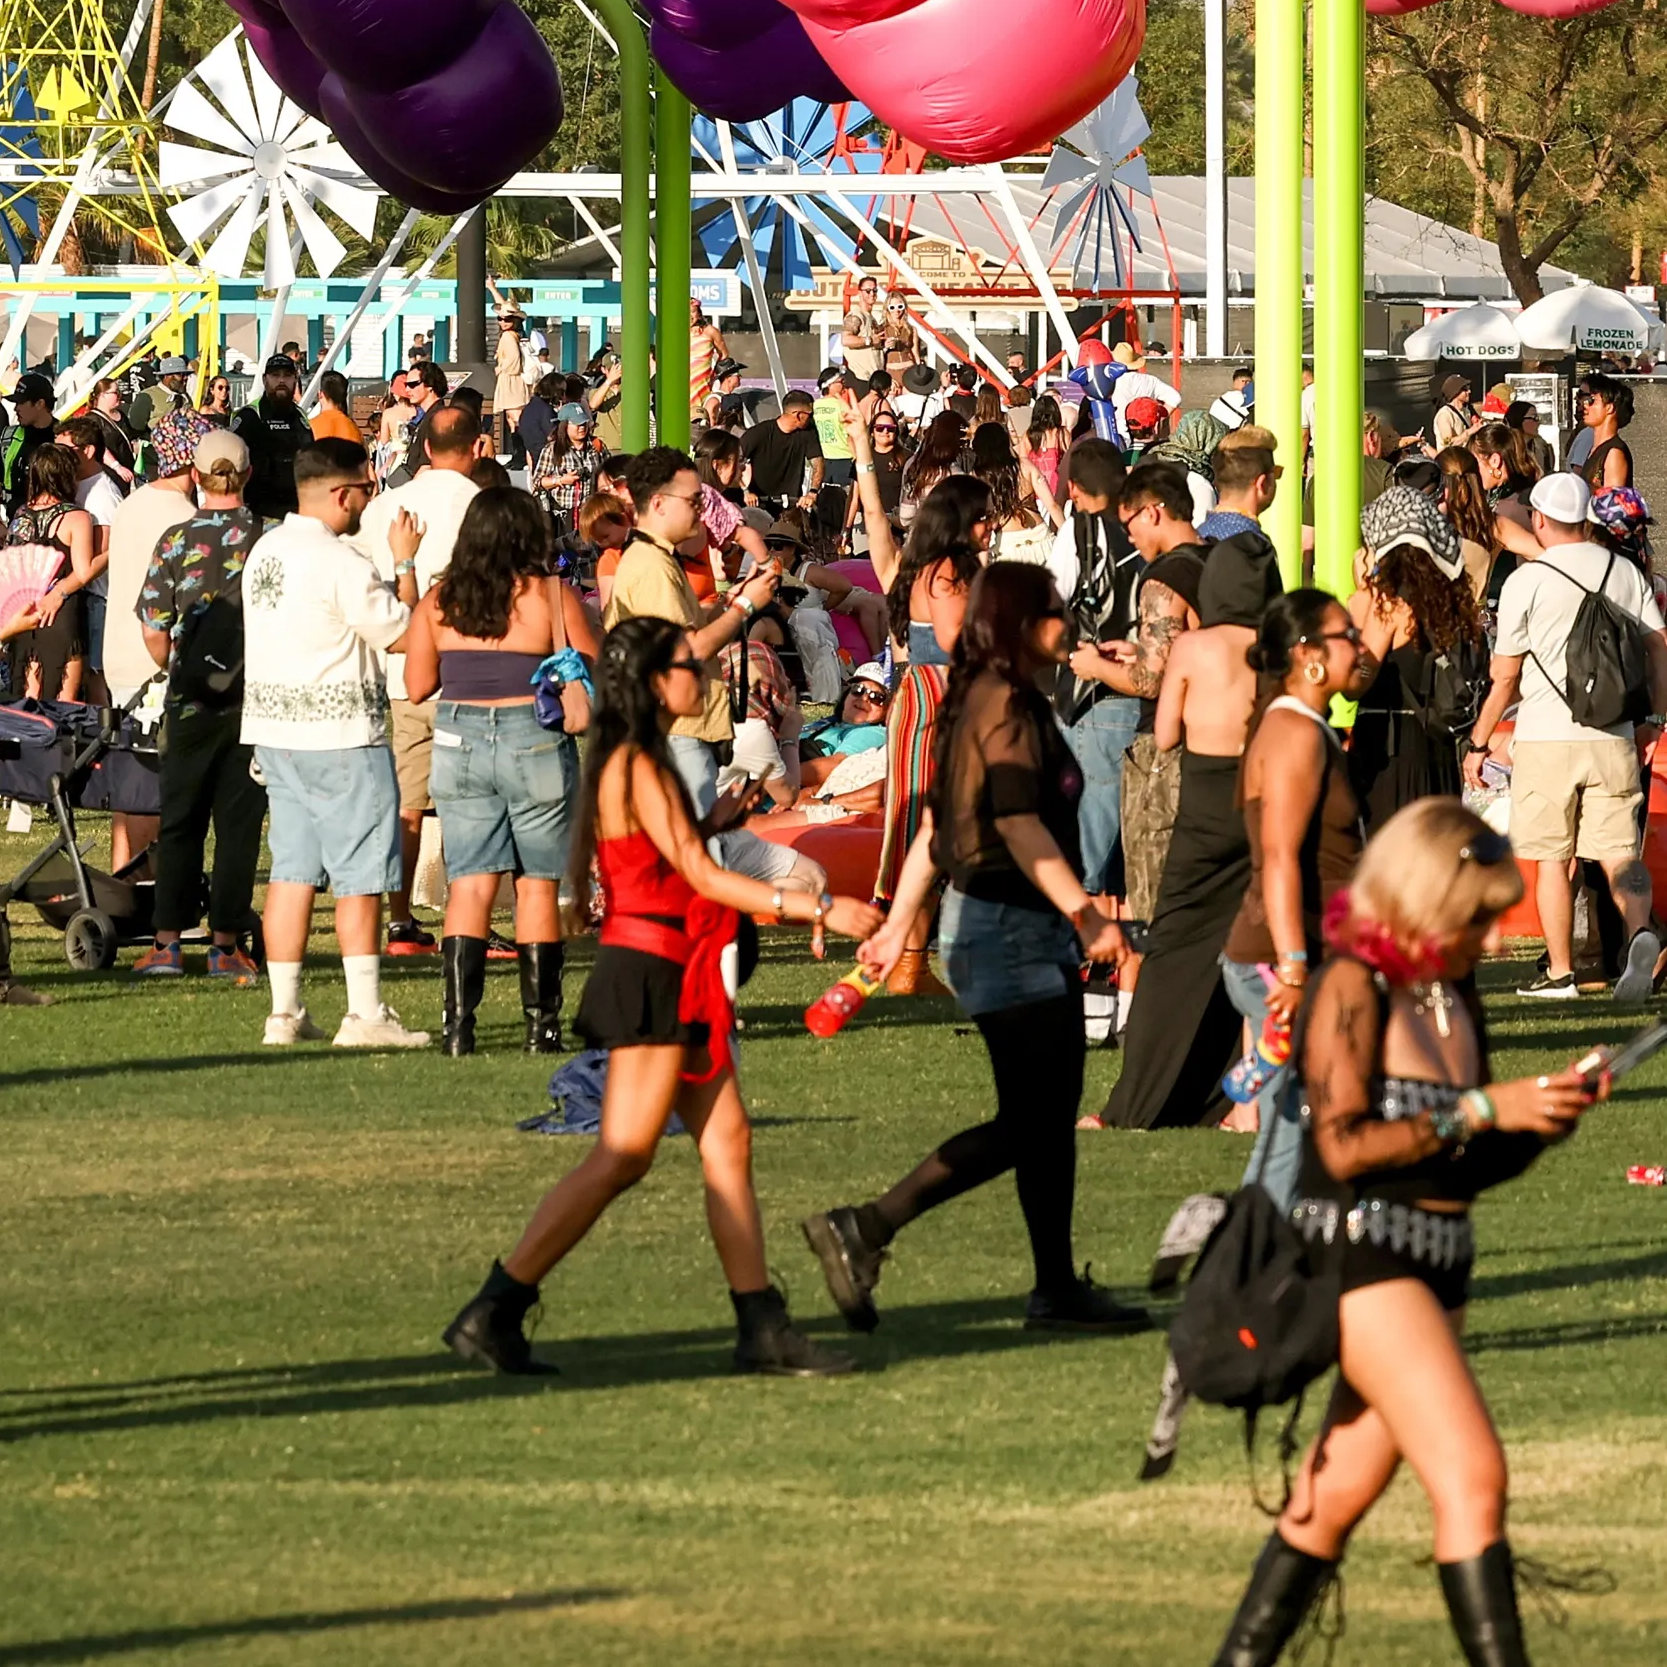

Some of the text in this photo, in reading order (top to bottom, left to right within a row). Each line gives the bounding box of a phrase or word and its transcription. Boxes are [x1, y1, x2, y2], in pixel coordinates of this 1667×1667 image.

[544, 291, 572, 300] ENTER
[1587, 328, 1634, 339] FROZEN
[1580, 338, 1644, 350] LEMONADE
[1446, 345, 1515, 355] HOT DOGS
[269, 423, 291, 431] POLICE
